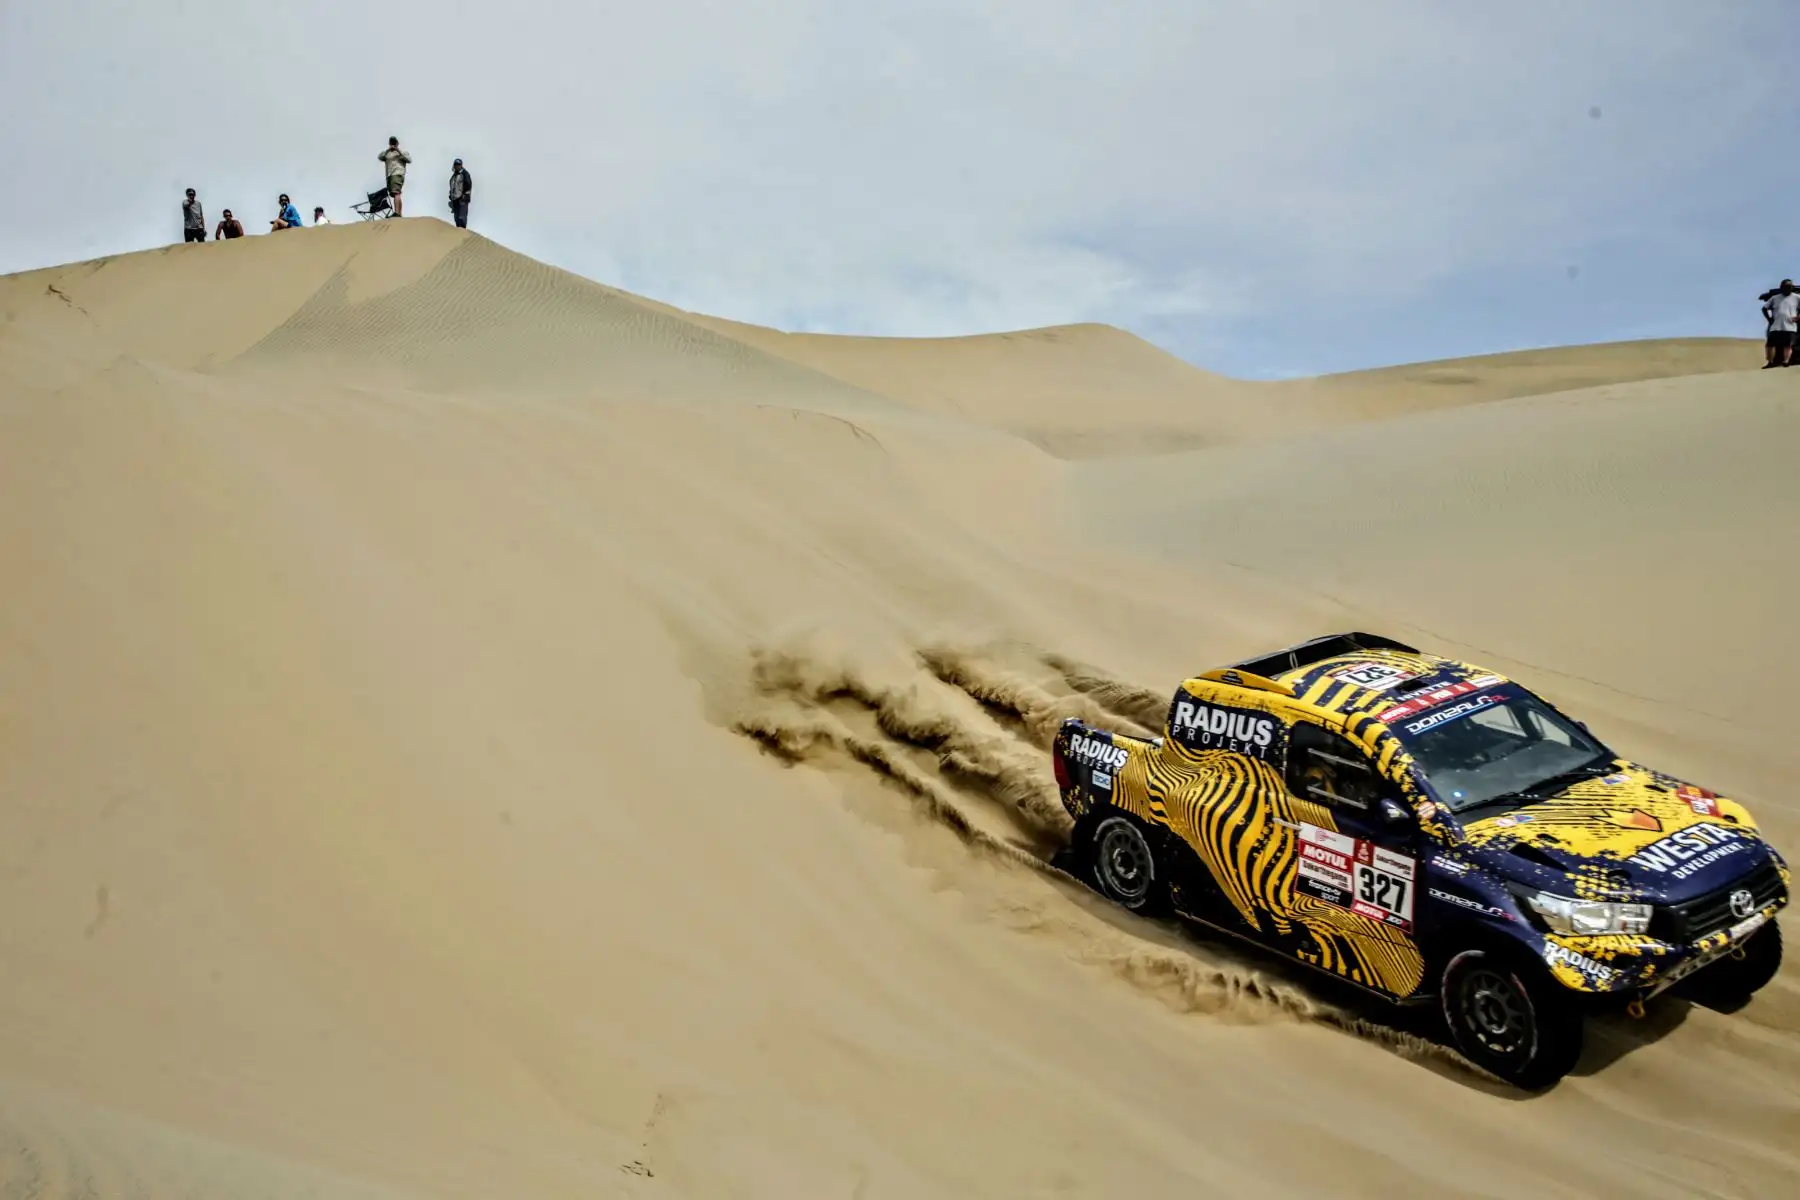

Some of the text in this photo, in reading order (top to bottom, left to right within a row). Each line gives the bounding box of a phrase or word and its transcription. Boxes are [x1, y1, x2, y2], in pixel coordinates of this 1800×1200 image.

[1172, 725, 1268, 759] PROJEKT
[1175, 701, 1273, 746] RADIUS
[1070, 733, 1128, 768] RADIUS
[1303, 844, 1348, 869] MOTUL
[1628, 822, 1739, 873] WESTA
[1671, 842, 1745, 879] DEVELOPMENT
[1360, 867, 1406, 913] 327
[1354, 903, 1385, 919] MOTUL
[1543, 941, 1613, 980] RADIUS
